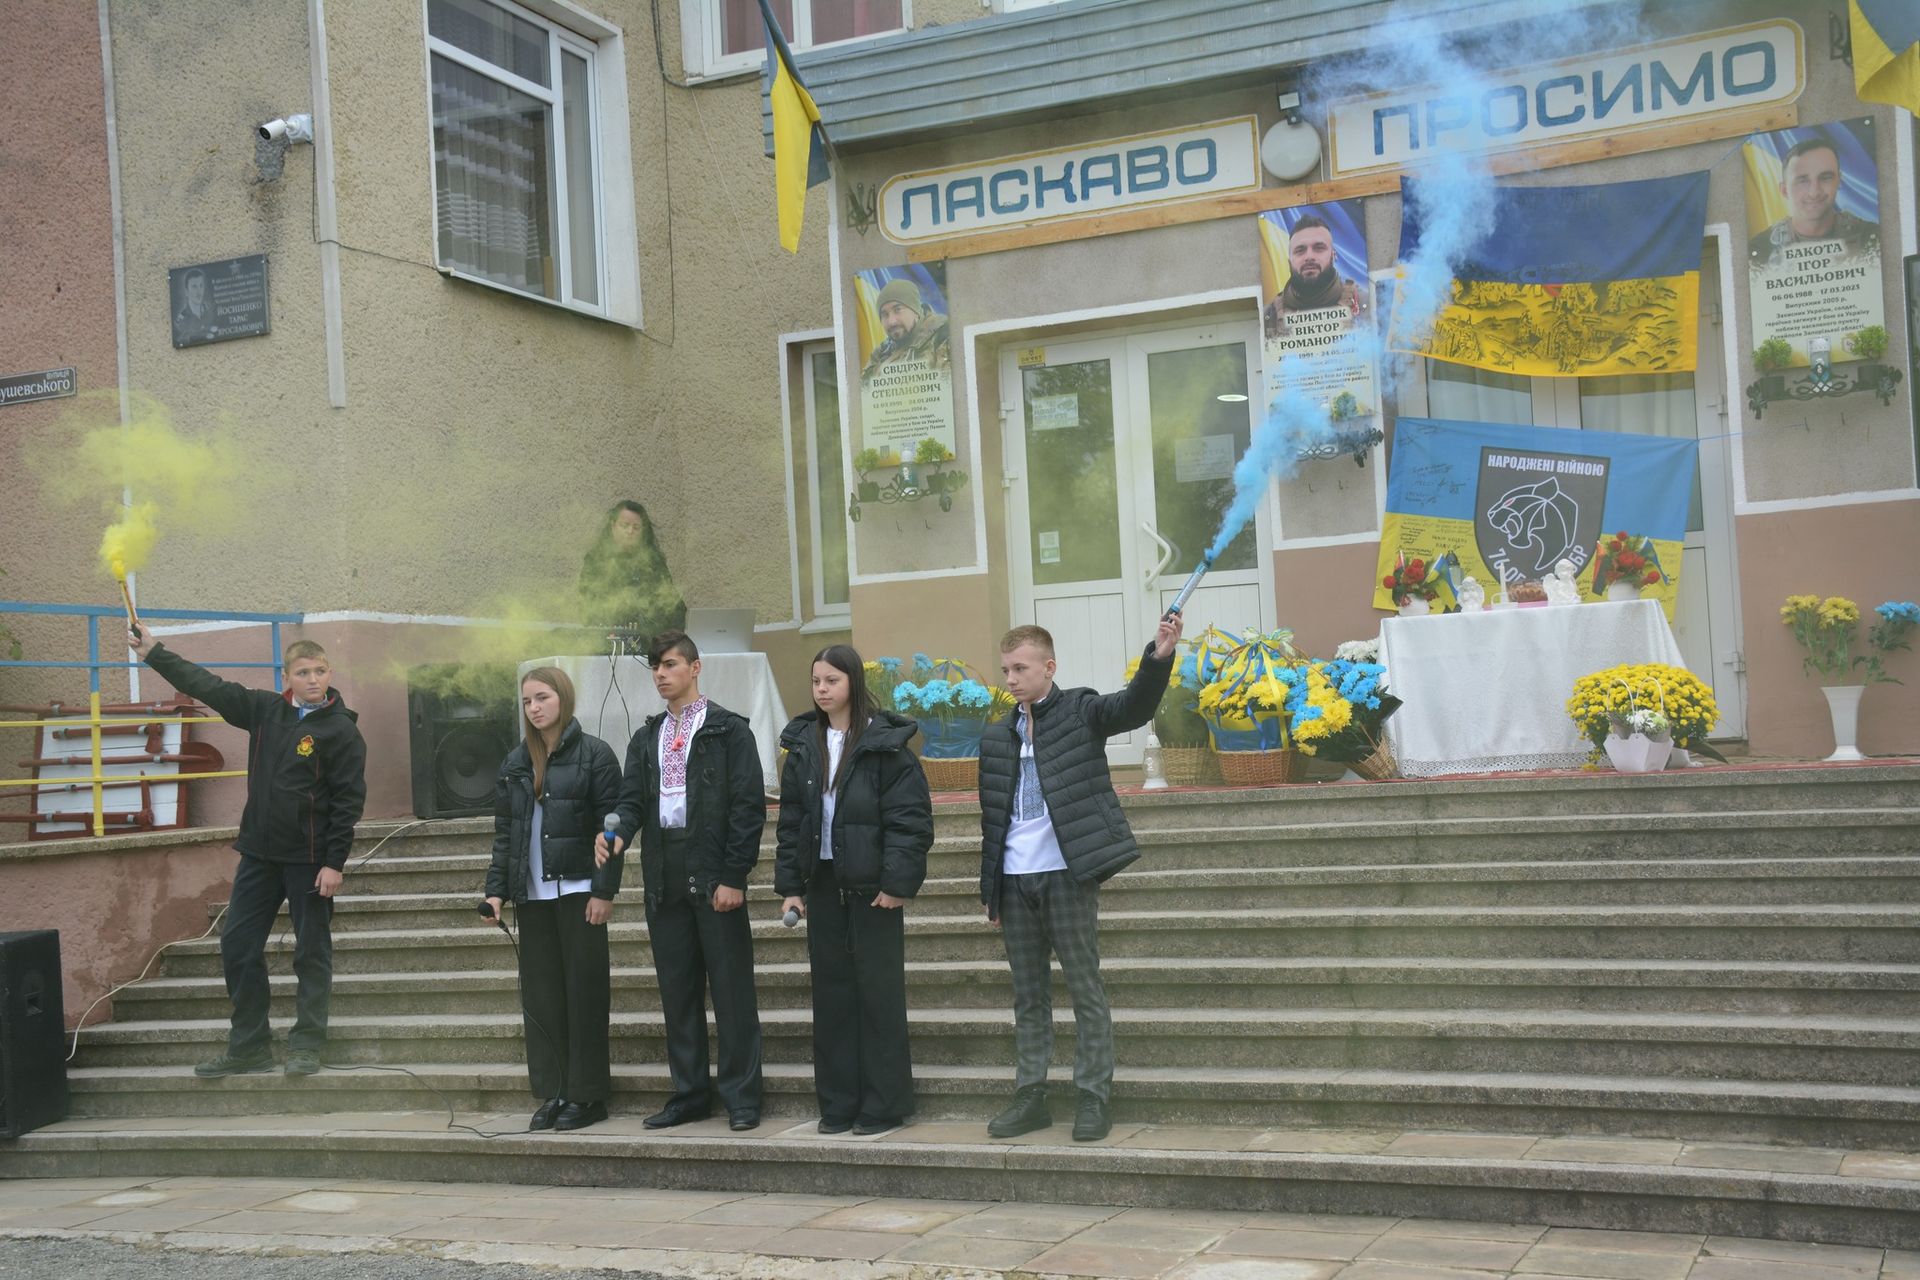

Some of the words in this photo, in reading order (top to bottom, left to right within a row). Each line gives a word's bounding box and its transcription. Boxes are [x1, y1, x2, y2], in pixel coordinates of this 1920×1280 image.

[1373, 40, 1776, 155] ПРОСИМО
[900, 138, 1217, 230] ЛАСКАВО
[1785, 243, 1843, 260] БАКОТА
[1798, 258, 1831, 272] ІГОР
[1765, 267, 1867, 290] ВАСИЛЬОВИЧ
[1286, 309, 1347, 324] КЛИМ'ЮК
[1295, 322, 1340, 336] ВІКТОР
[1280, 333, 1356, 350] РОМАНОВ
[883, 361, 928, 375] СВІДРУК
[873, 372, 939, 388] ВОЛОДИМИР
[0, 379, 70, 402] ушевського
[871, 383, 941, 399] СТЕПАНОВИЧ
[1488, 454, 1555, 473] НАРОДЖЕНІ
[1556, 459, 1605, 476] ВІЙНОЮ
